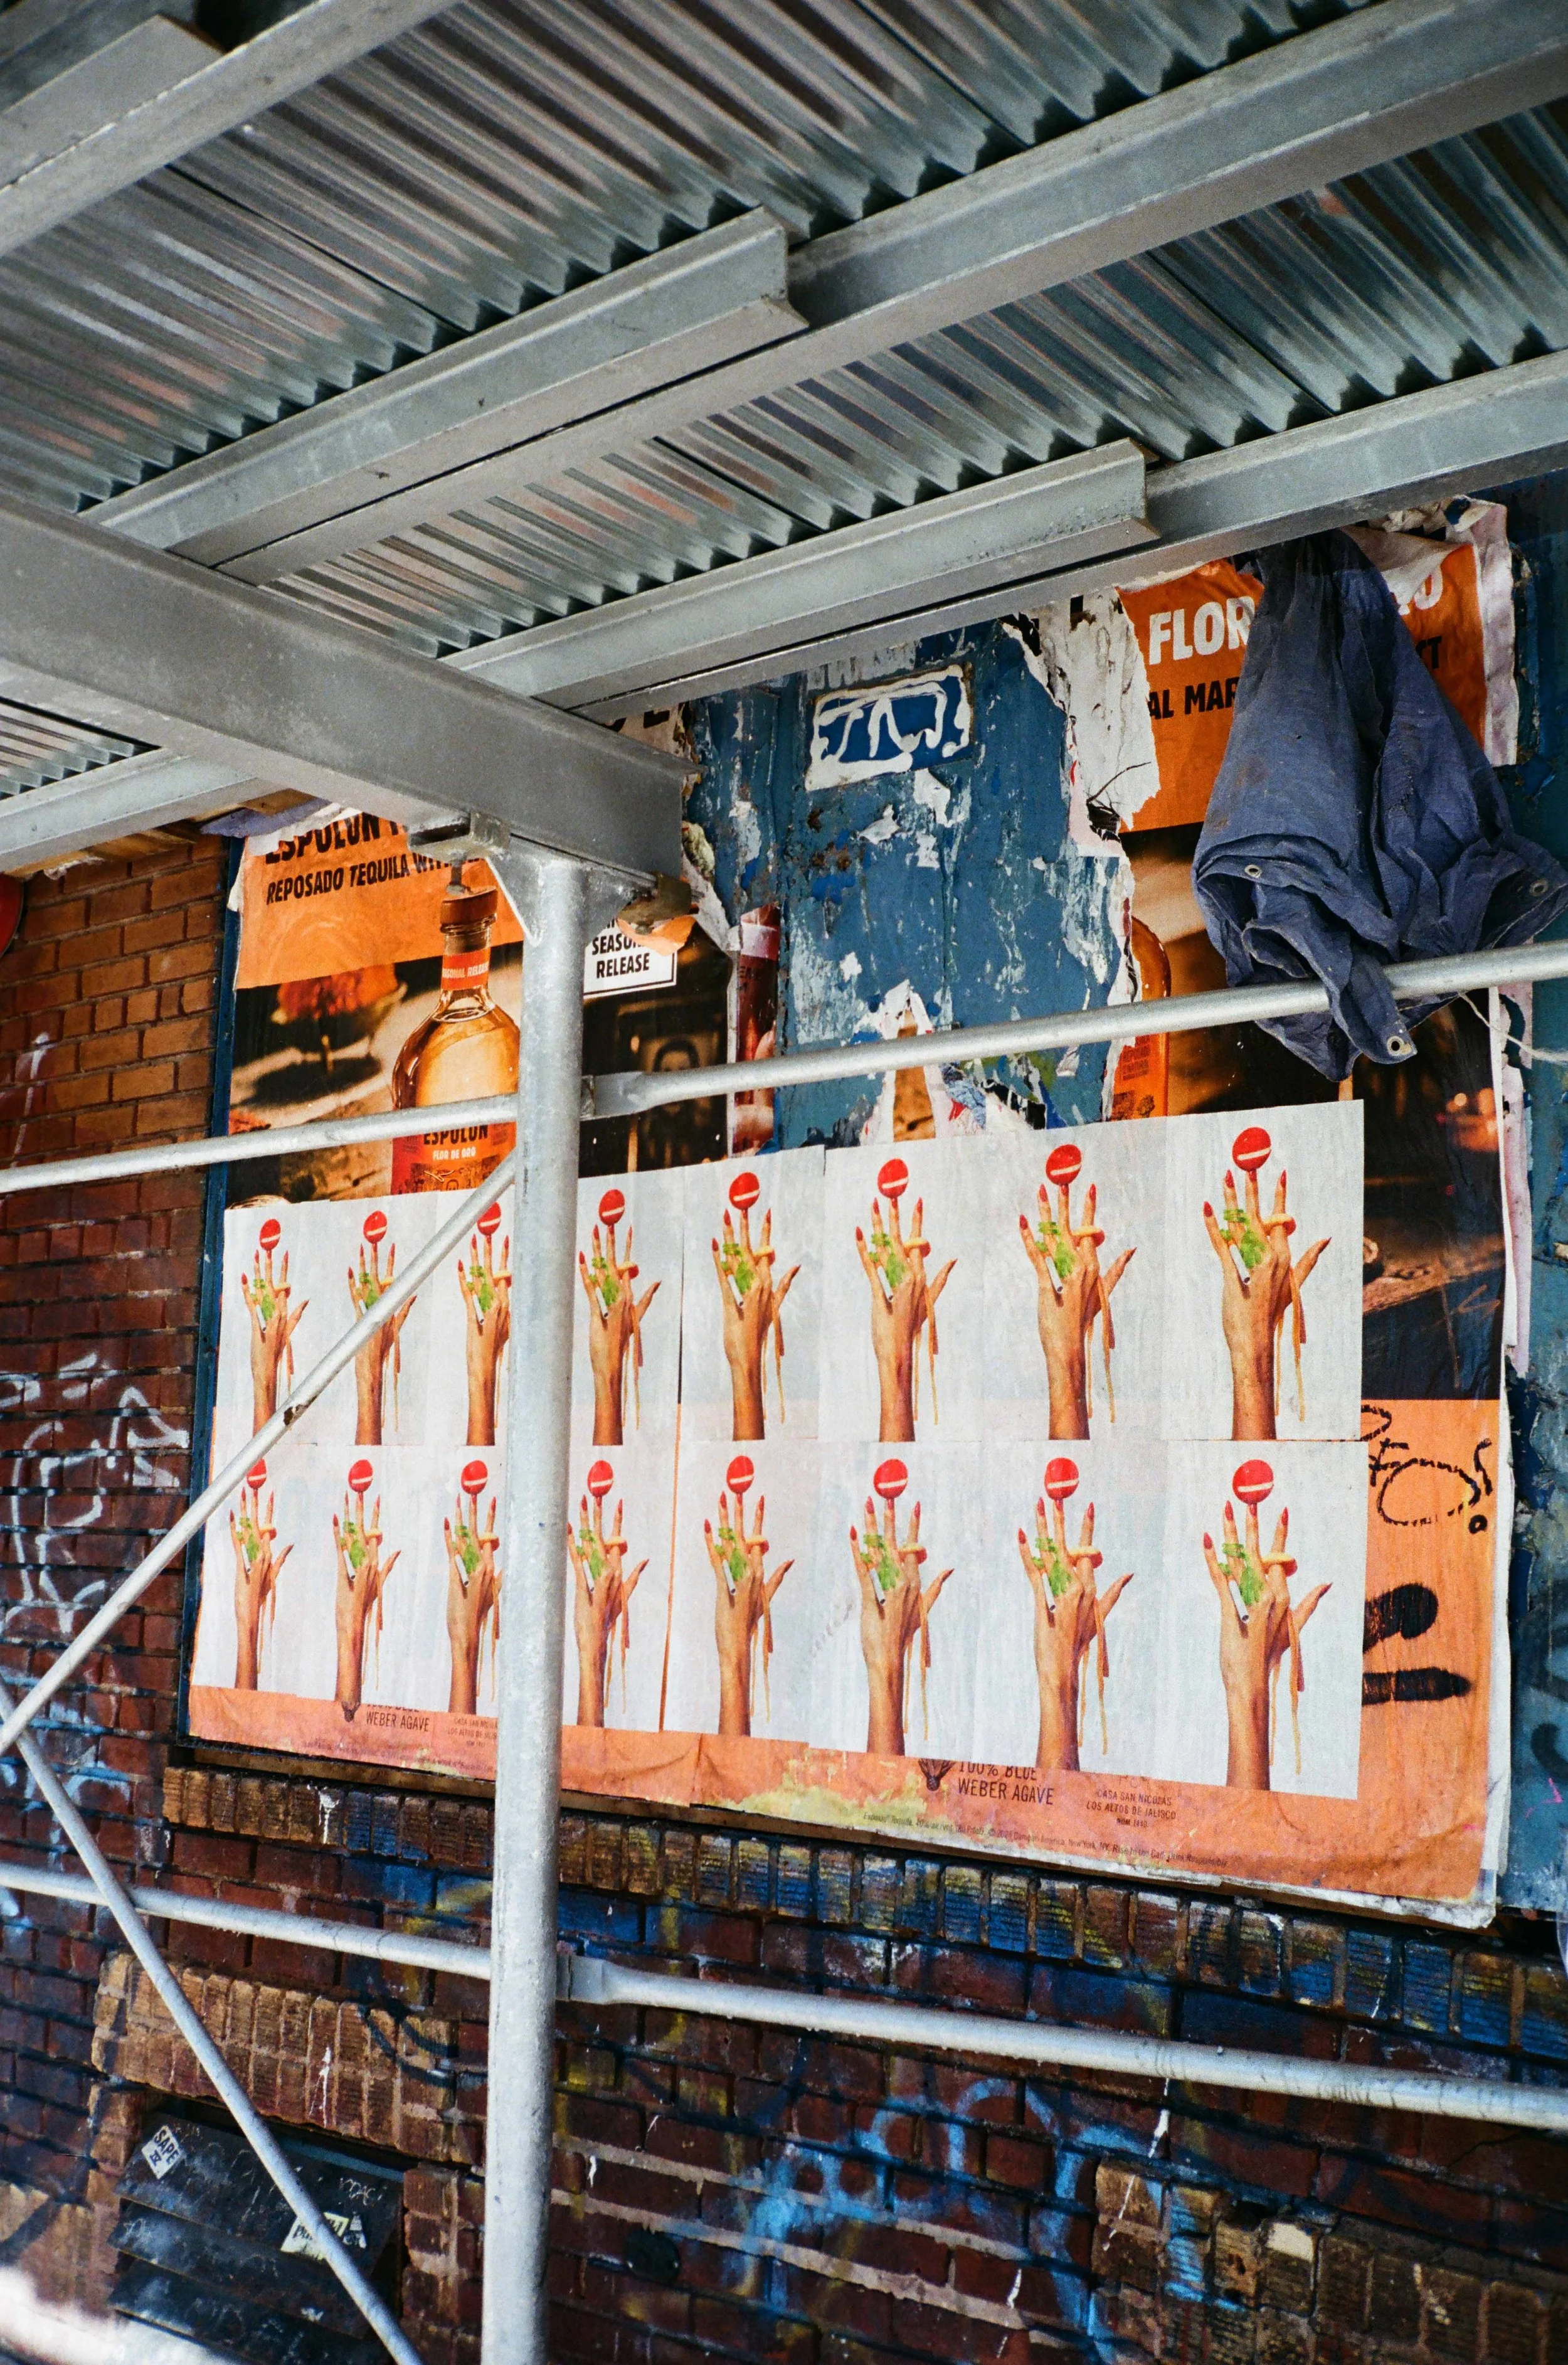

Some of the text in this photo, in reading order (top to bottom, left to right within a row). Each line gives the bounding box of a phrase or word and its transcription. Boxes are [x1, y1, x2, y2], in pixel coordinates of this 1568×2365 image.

[1149, 595, 1255, 665] FLOR
[266, 868, 344, 905] REPOSADO
[349, 854, 410, 887] TEQUILA
[596, 953, 650, 979] RELEASE
[433, 1150, 448, 1160] FLOR
[451, 1149, 460, 1159] DE
[366, 1711, 430, 1732] WEBER AGAVE
[958, 1778, 1054, 1805] WEBER AGAVE
[1097, 1789, 1117, 1800] CASA
[1120, 1792, 1135, 1802] SAN
[1086, 1800, 1177, 1820] LOS ALTOS DE JALISCO
[154, 2129, 179, 2165] SAPE
